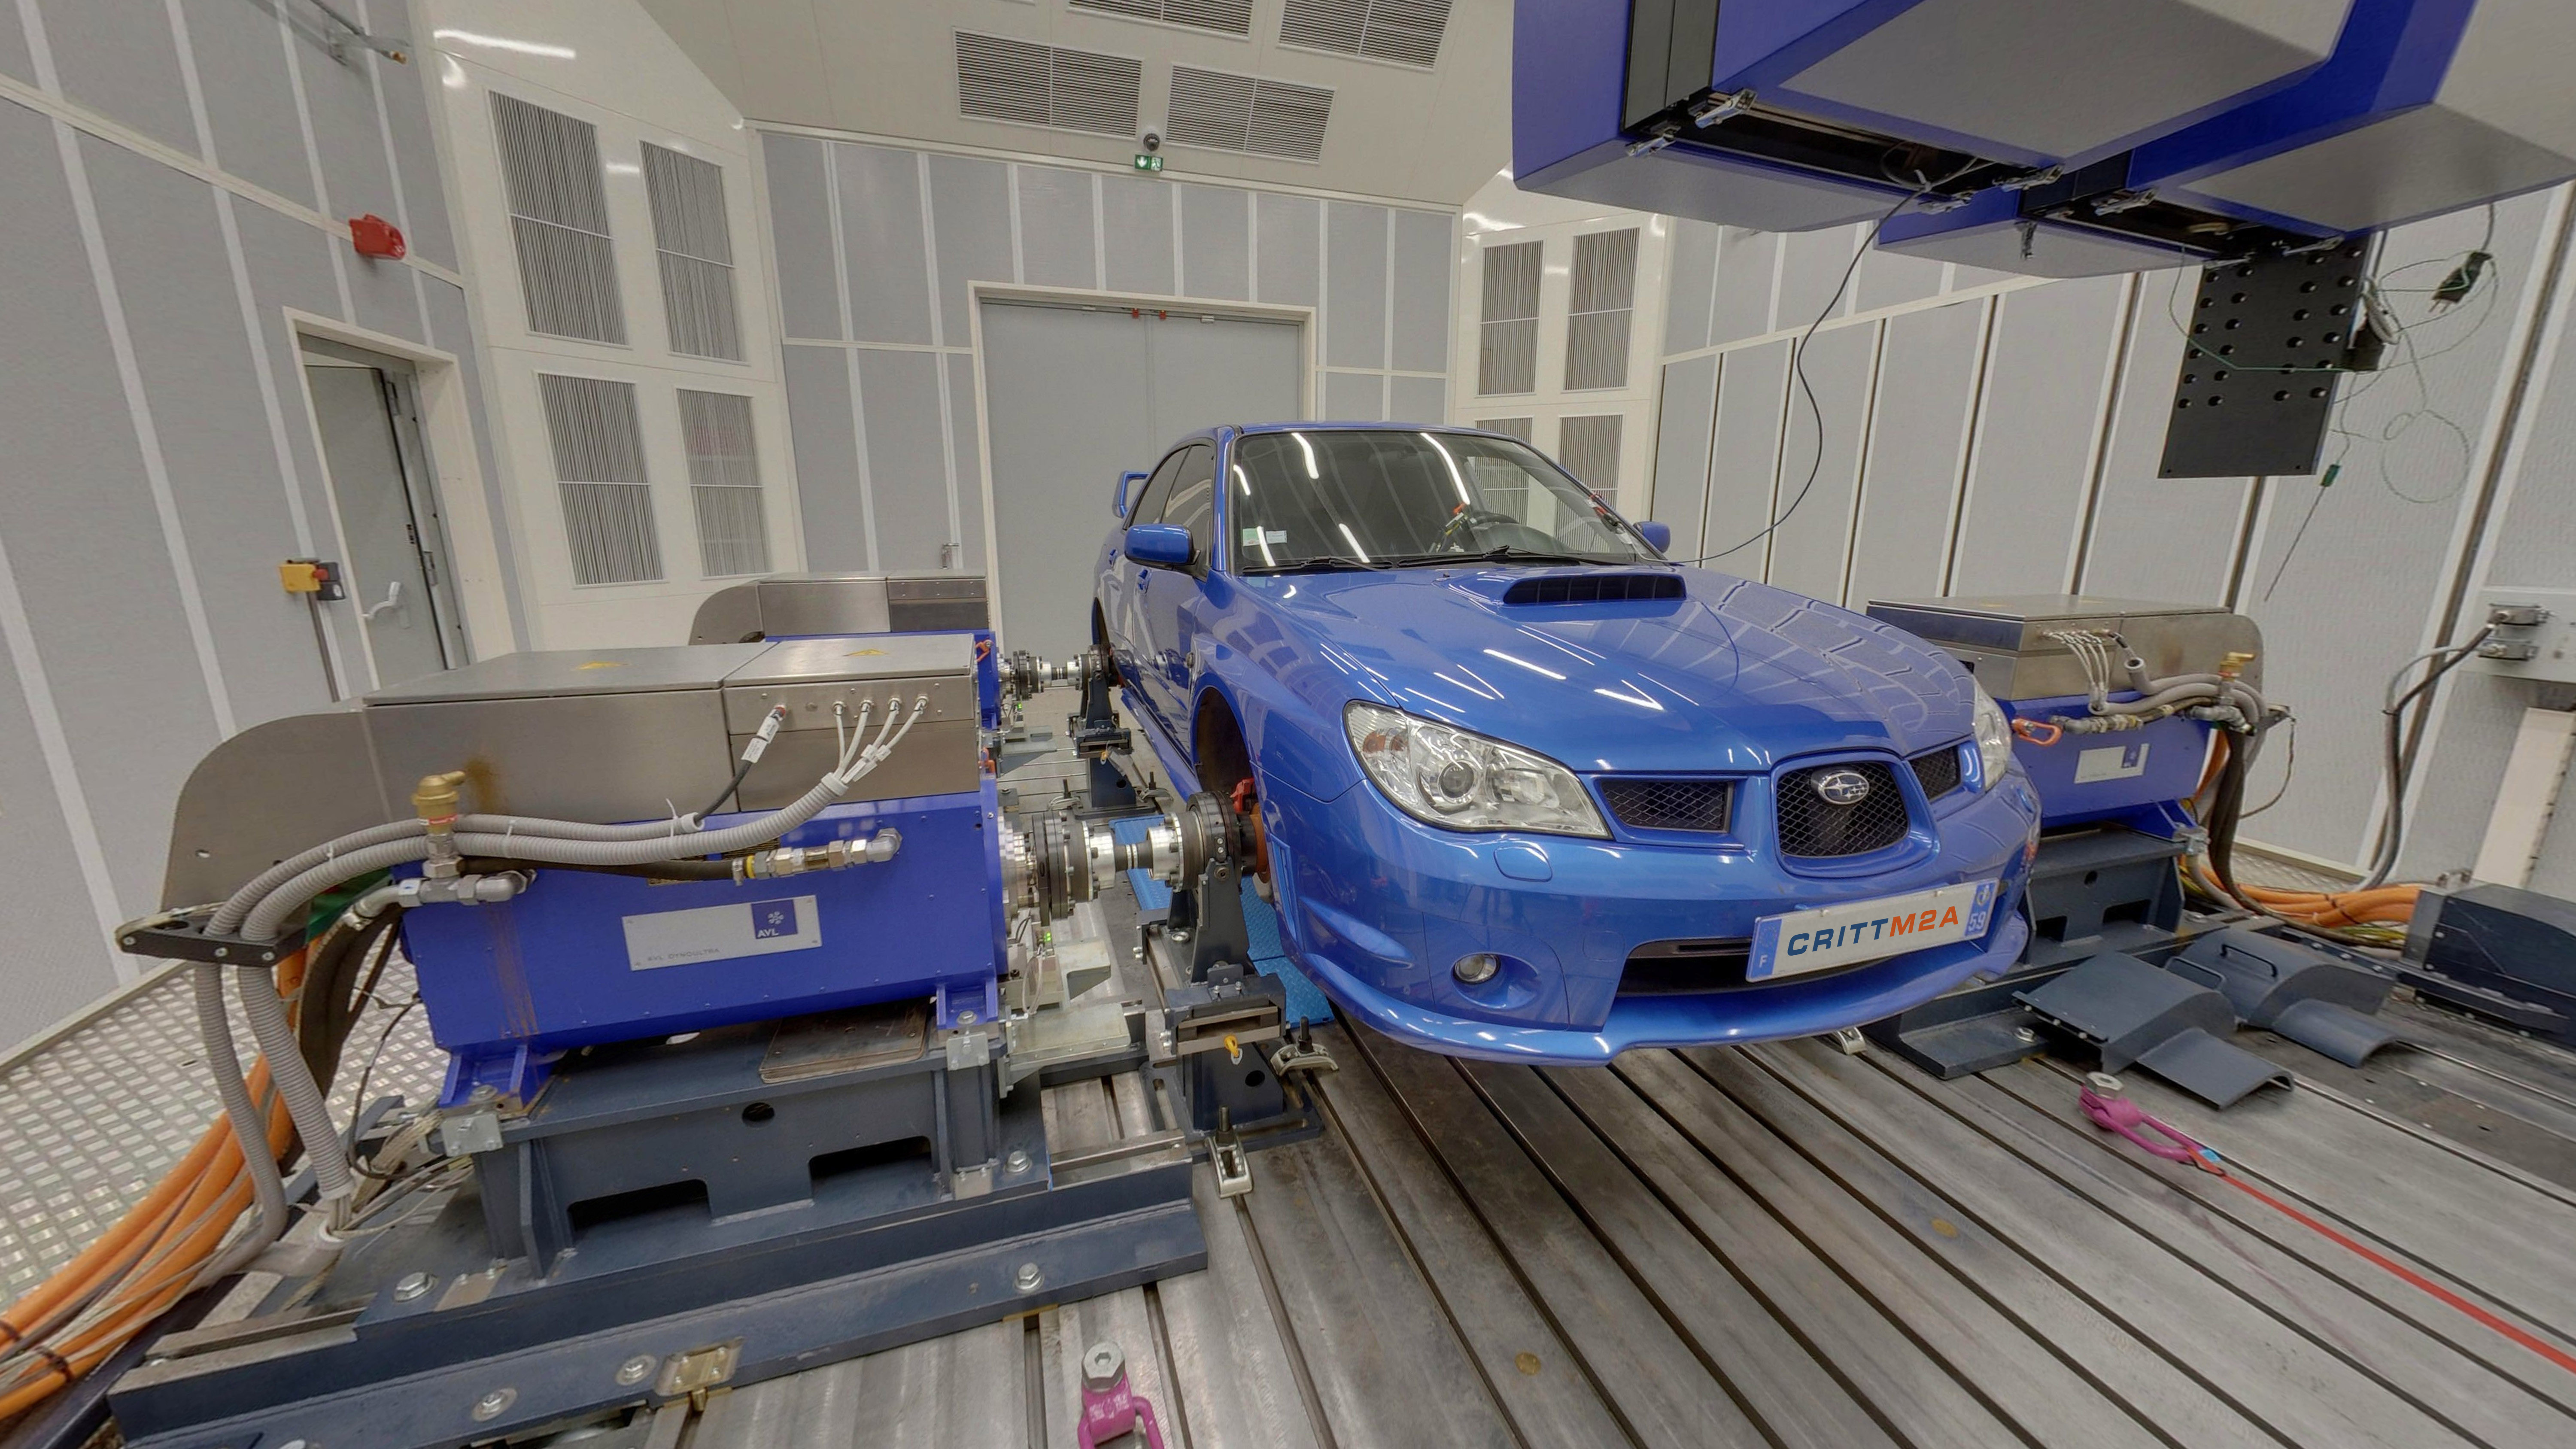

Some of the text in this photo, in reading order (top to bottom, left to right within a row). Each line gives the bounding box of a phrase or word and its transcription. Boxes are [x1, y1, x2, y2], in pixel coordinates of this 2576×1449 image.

[1968, 911, 1987, 931] 59
[757, 928, 779, 938] AVL
[1787, 906, 1959, 956] CRITTM2A
[1759, 954, 1768, 968] F
